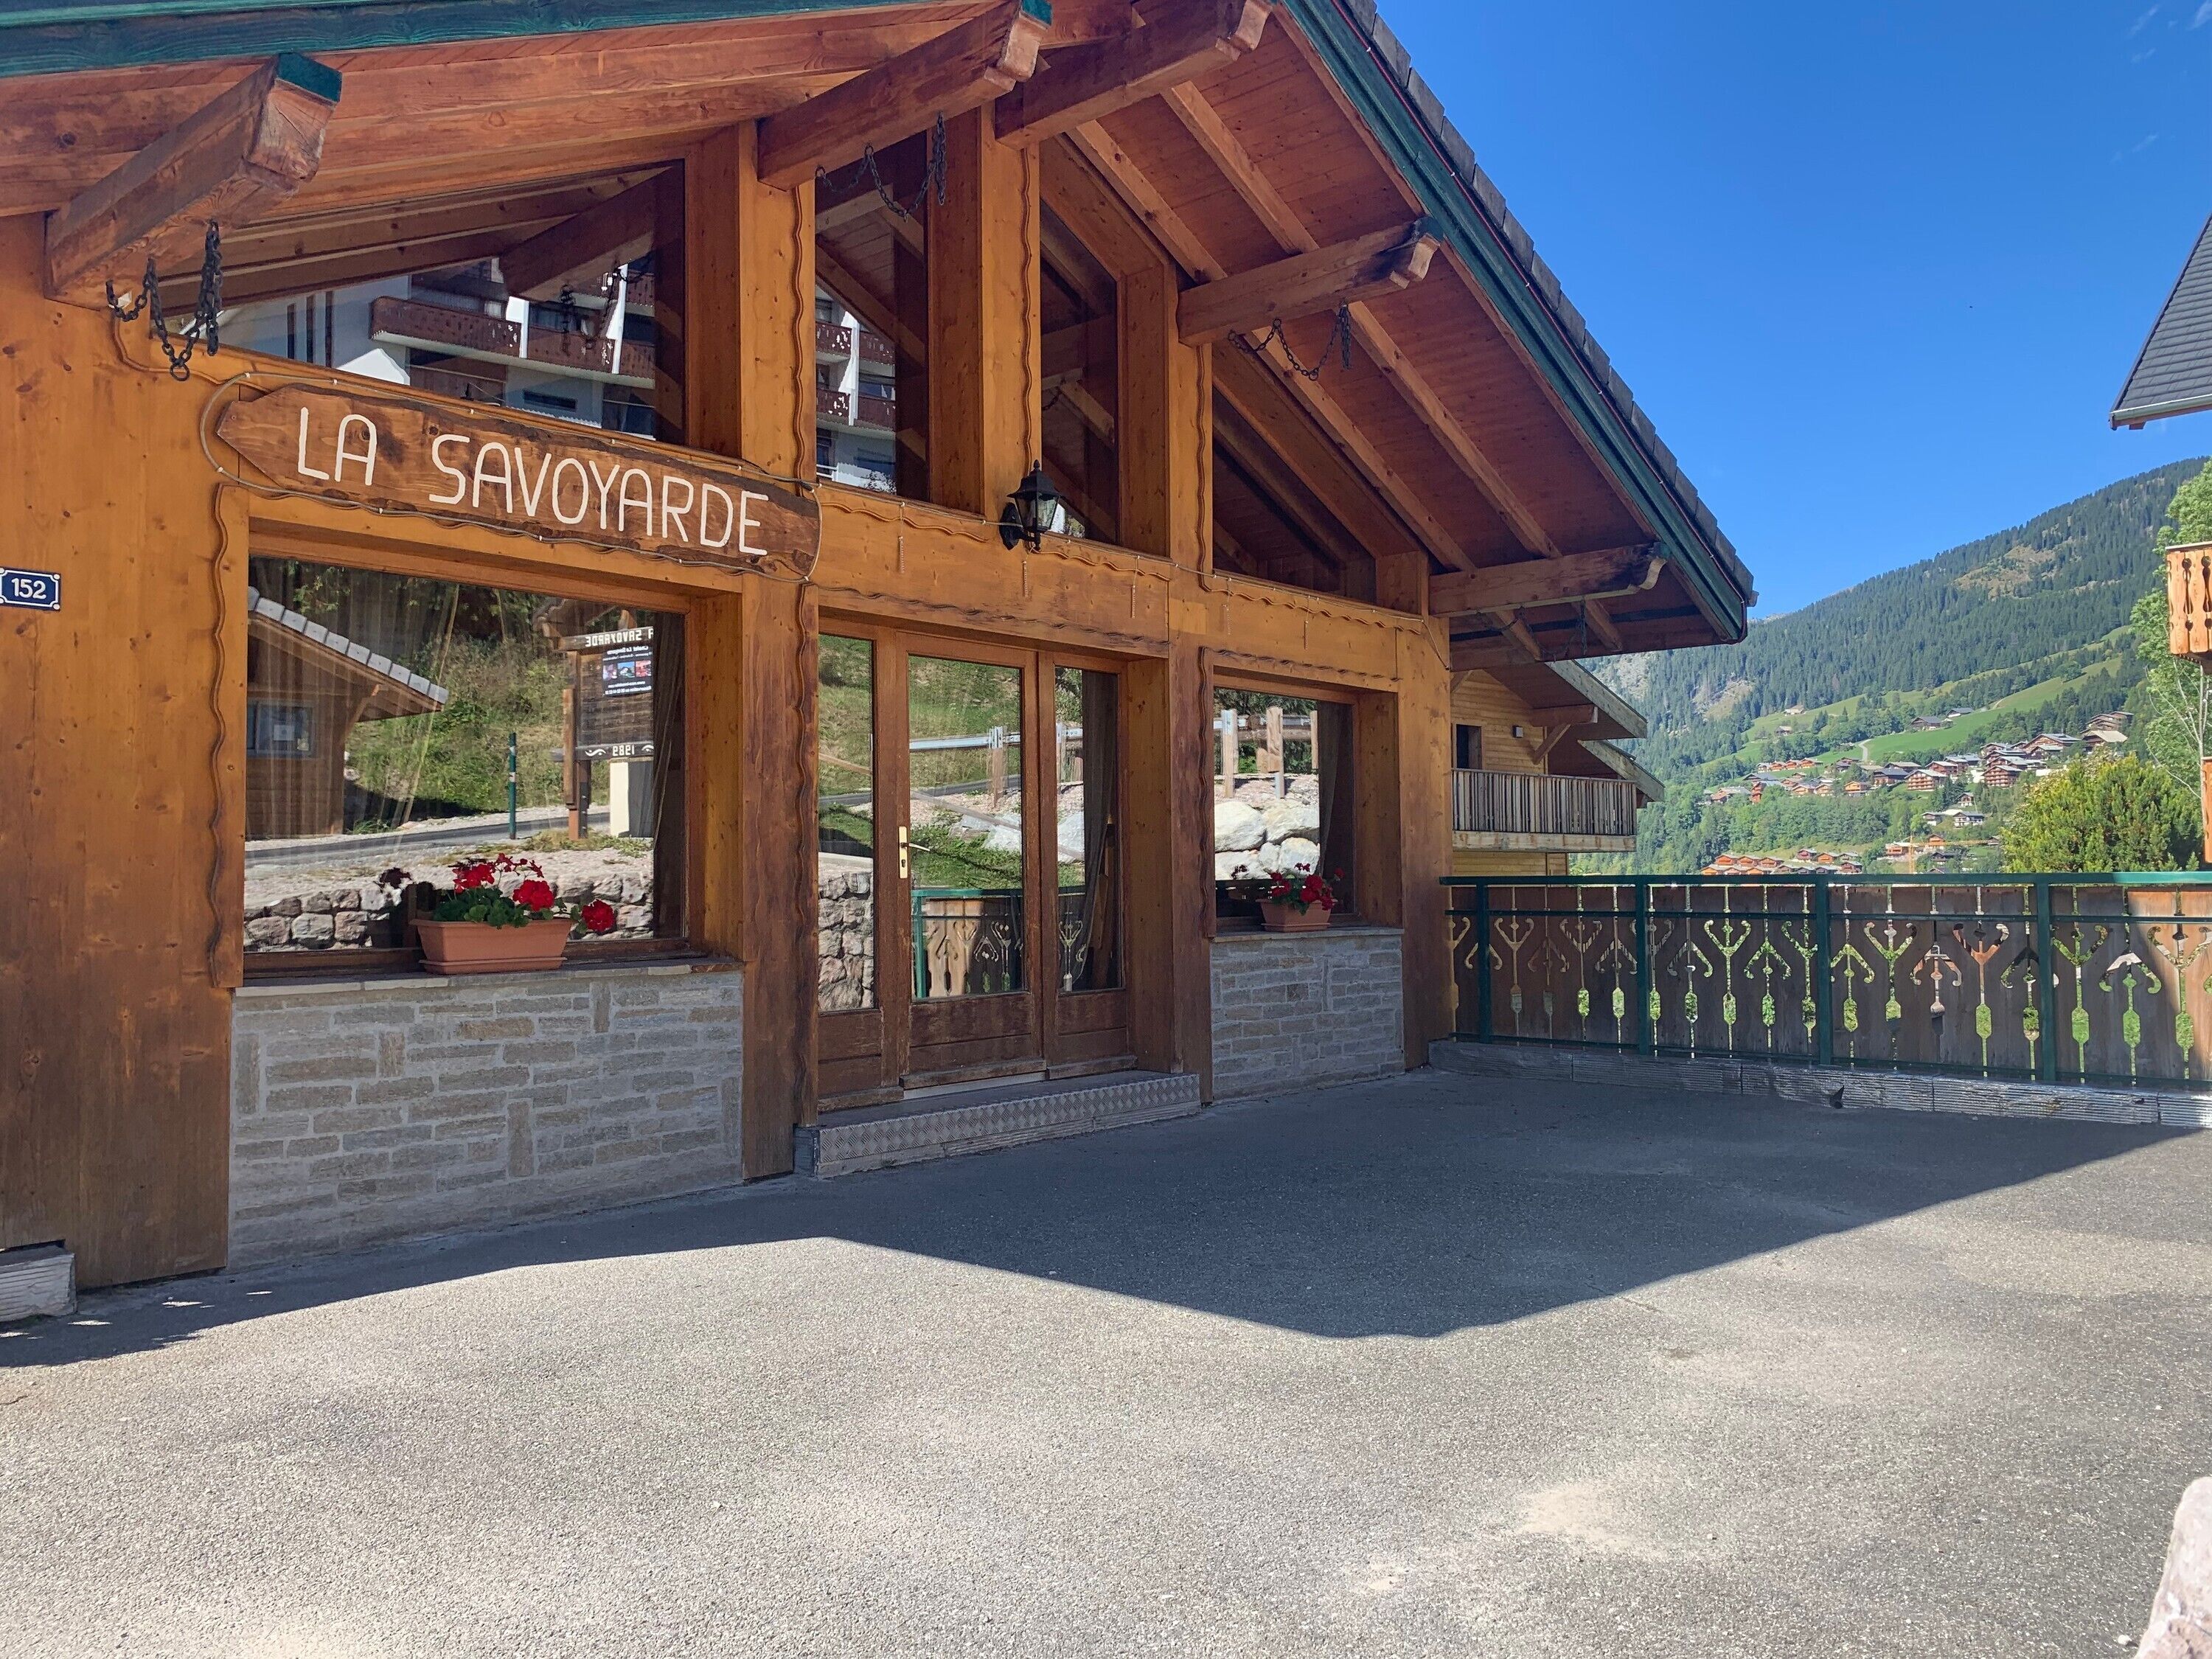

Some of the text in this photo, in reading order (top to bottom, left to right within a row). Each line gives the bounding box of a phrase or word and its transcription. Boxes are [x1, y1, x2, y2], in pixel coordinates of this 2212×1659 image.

[296, 406, 770, 557] LA SAVOYARDE
[11, 577, 47, 599] 152
